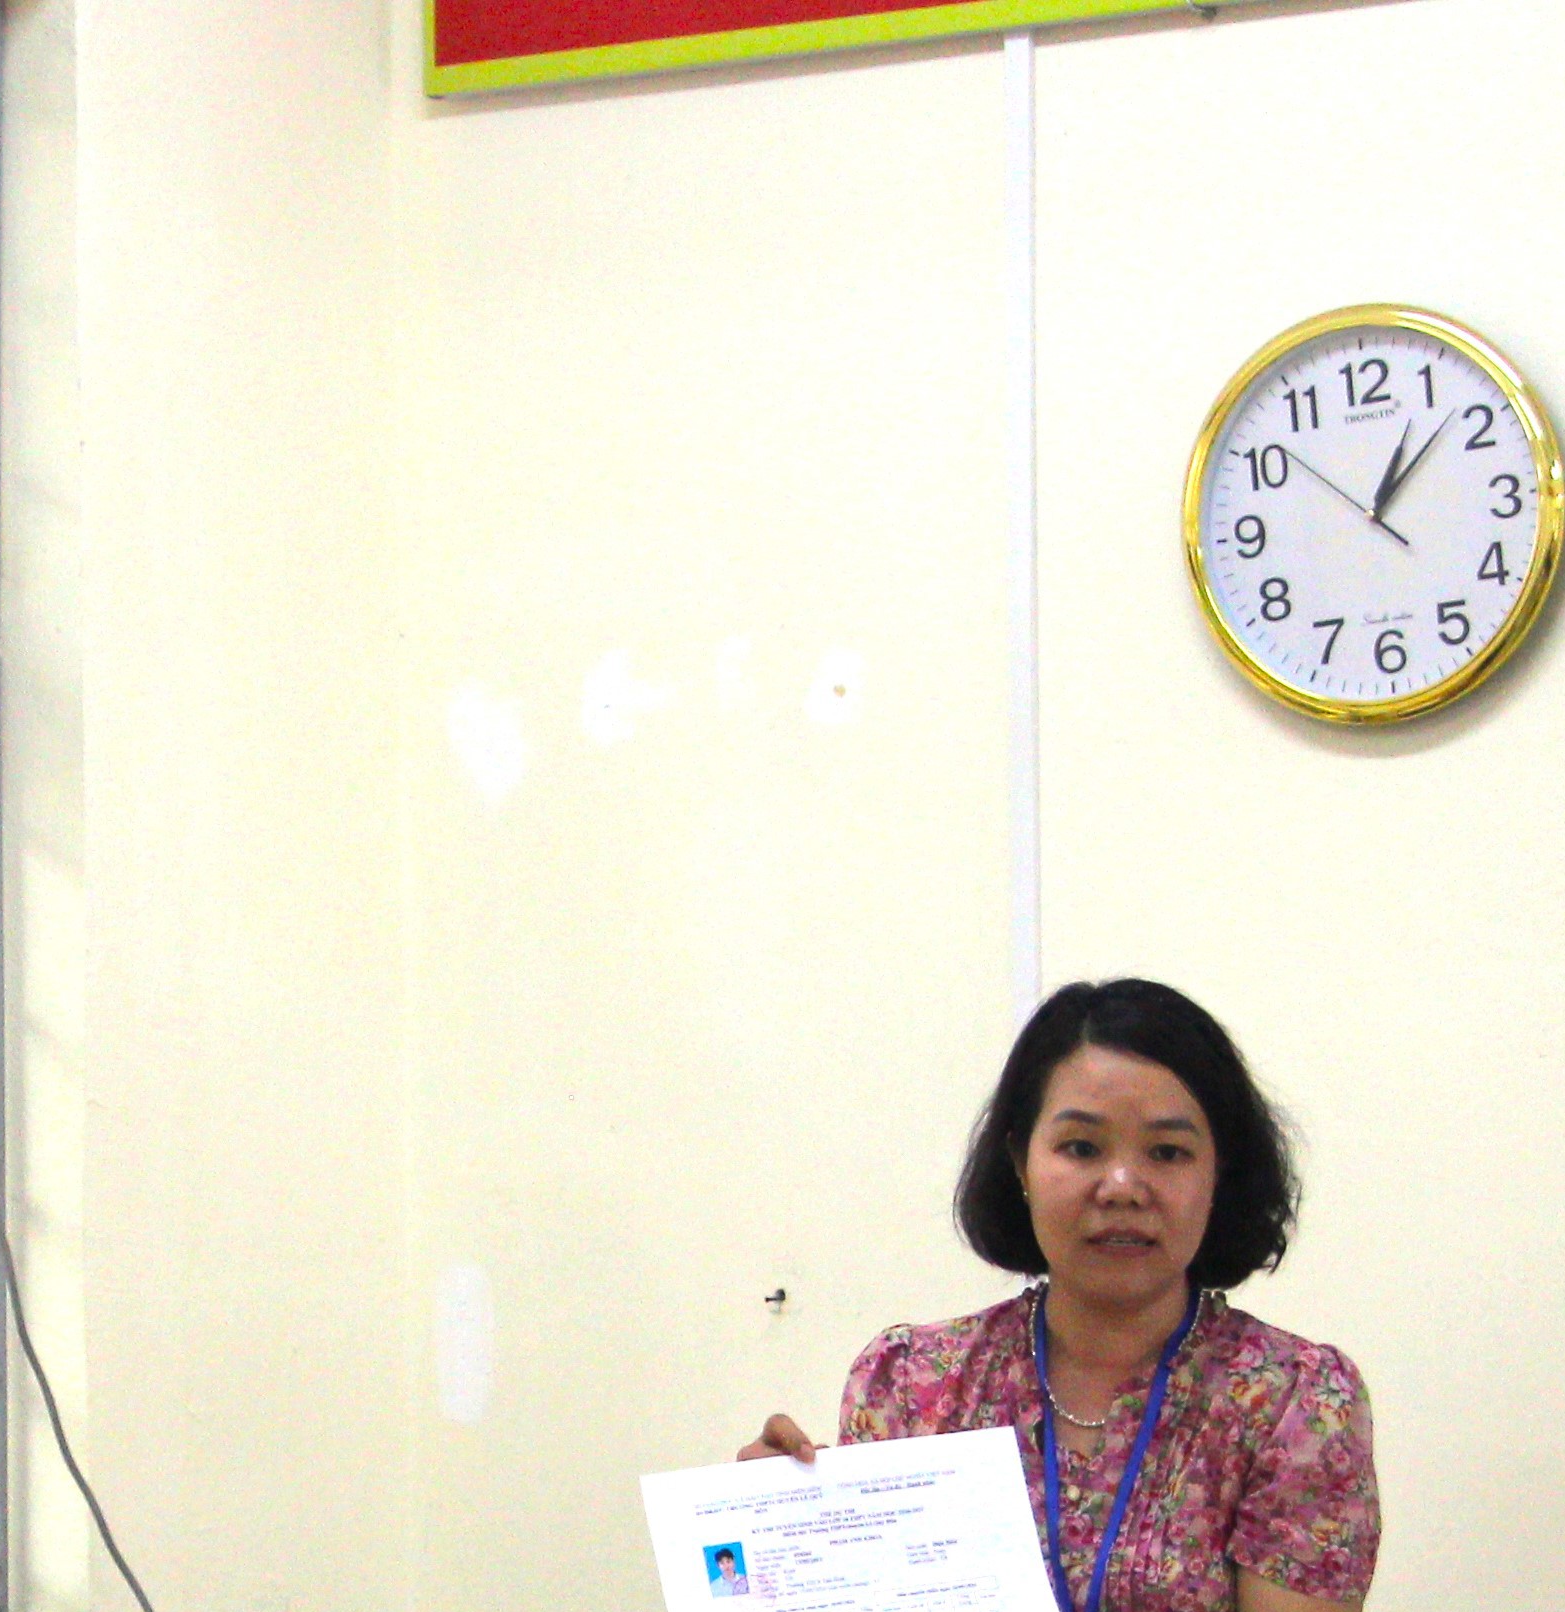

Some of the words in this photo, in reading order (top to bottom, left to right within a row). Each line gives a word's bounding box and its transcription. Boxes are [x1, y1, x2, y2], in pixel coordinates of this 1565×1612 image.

[1339, 359, 1391, 408] 12
[1417, 364, 1434, 409] 1
[1283, 385, 1320, 433] 11
[1461, 404, 1496, 451] 2
[1243, 444, 1289, 491] 10
[1488, 473, 1522, 519] 3
[1235, 515, 1266, 559] 9
[1477, 541, 1510, 586] 4
[1259, 577, 1292, 622] 8
[1313, 618, 1345, 665] 7
[1437, 600, 1470, 645] 5
[1373, 630, 1407, 674] 6
